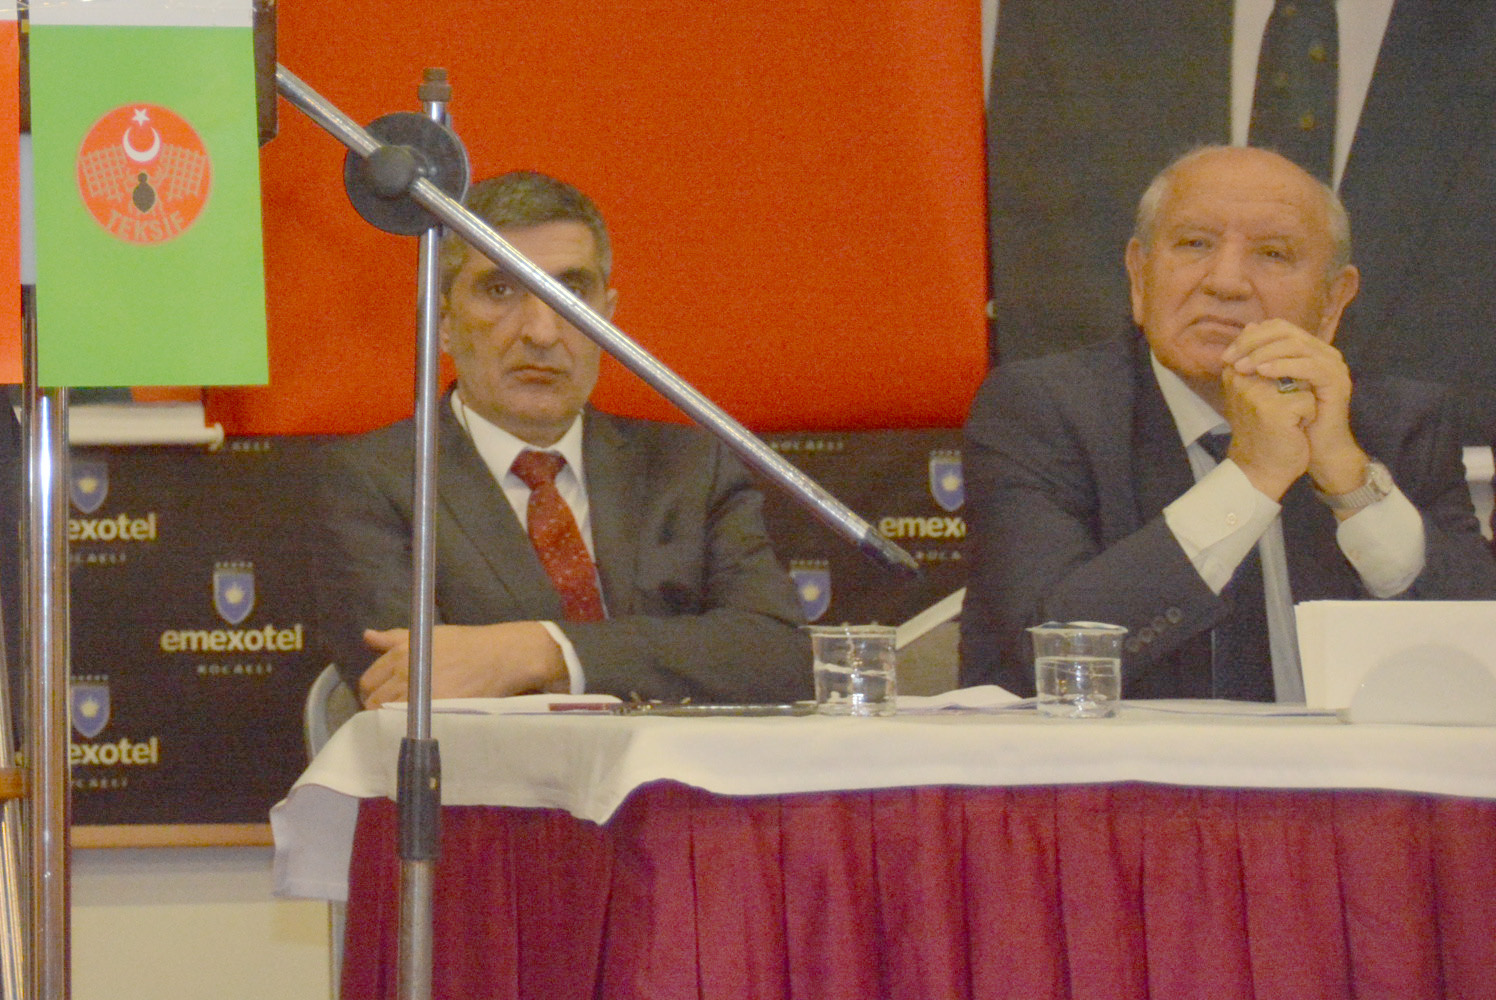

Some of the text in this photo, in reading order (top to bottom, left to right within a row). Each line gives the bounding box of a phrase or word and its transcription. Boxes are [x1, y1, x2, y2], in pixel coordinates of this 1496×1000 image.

[68, 512, 157, 541] exotel
[879, 516, 966, 539] emex
[159, 623, 303, 652] emexotel
[70, 736, 159, 766] exotel
